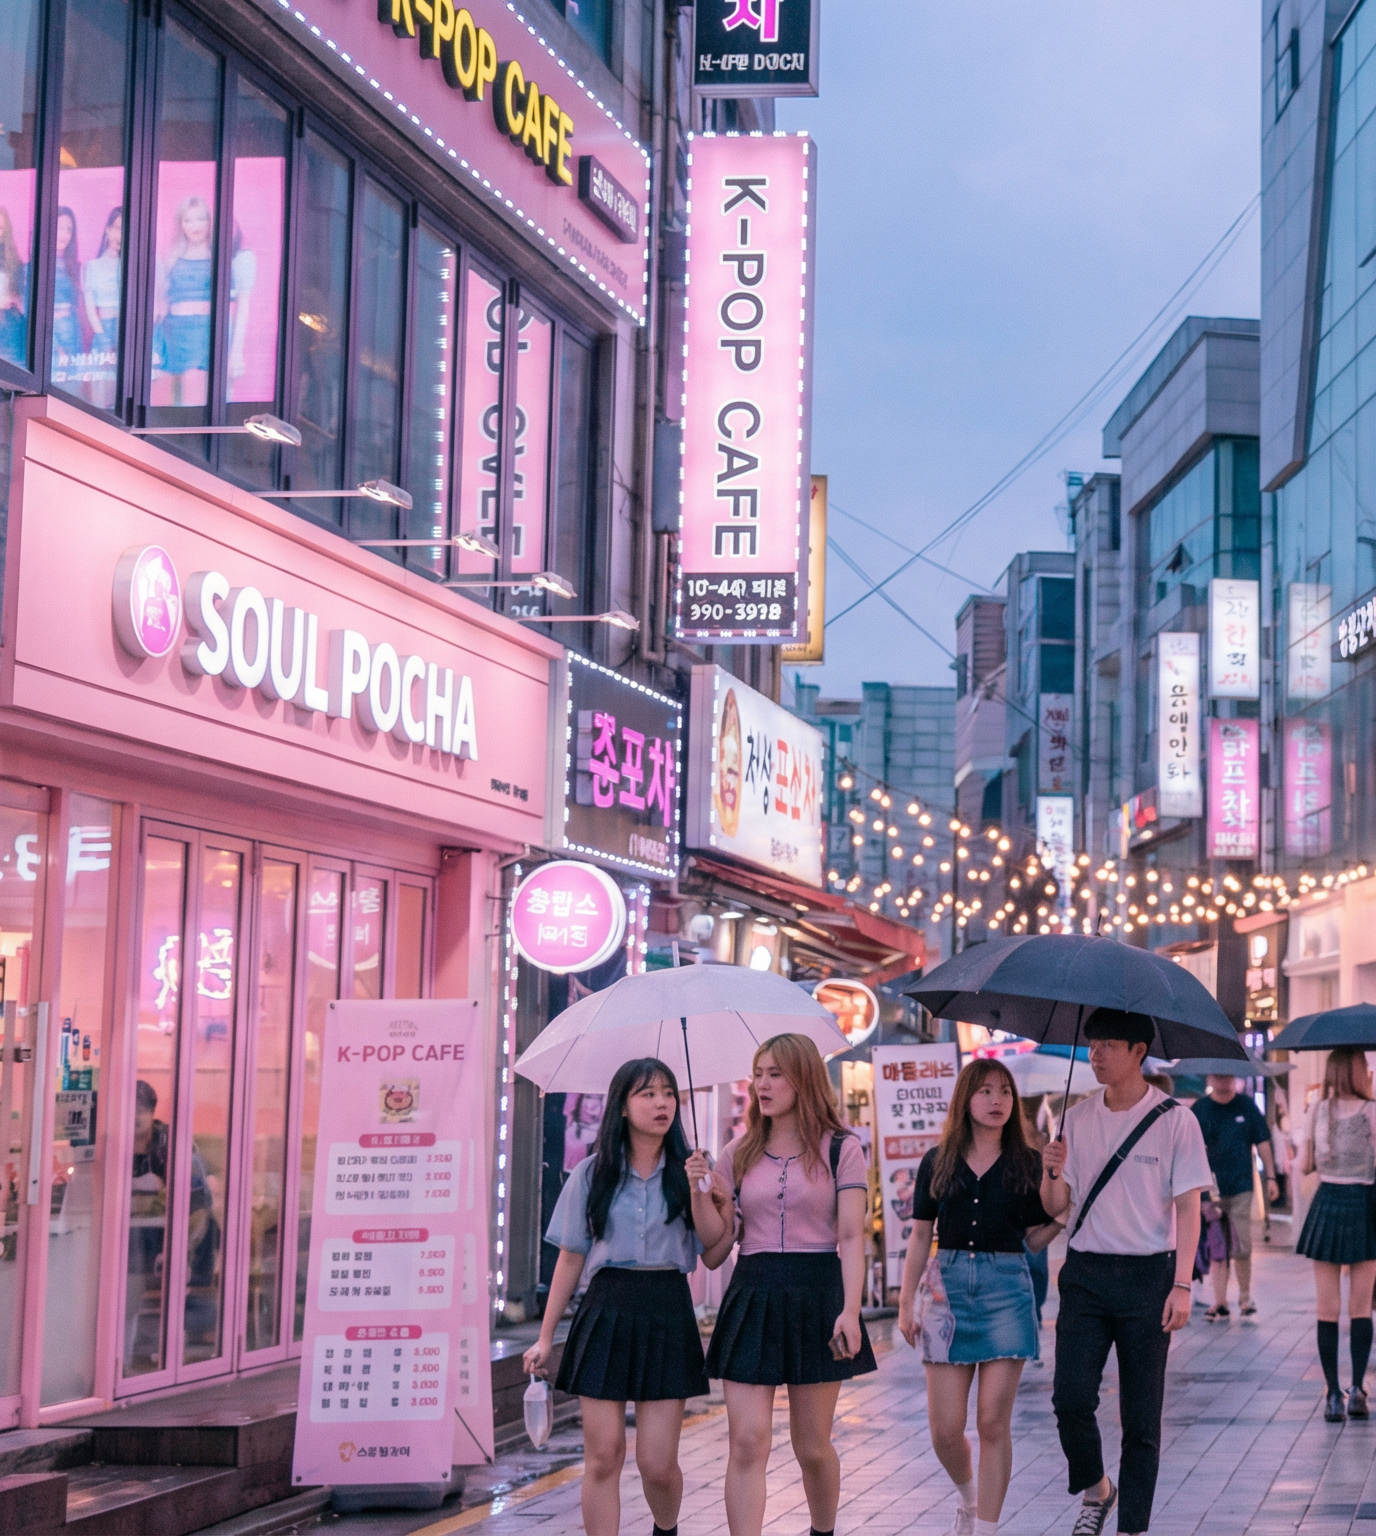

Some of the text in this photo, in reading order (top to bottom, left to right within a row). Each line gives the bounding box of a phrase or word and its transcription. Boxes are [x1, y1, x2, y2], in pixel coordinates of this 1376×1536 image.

[505, 60, 574, 186] CAFE
[713, 176, 768, 557] K-POP CAFE
[197, 571, 479, 762] SOUL POCHA
[337, 1044, 466, 1063] K-POP CAFE
